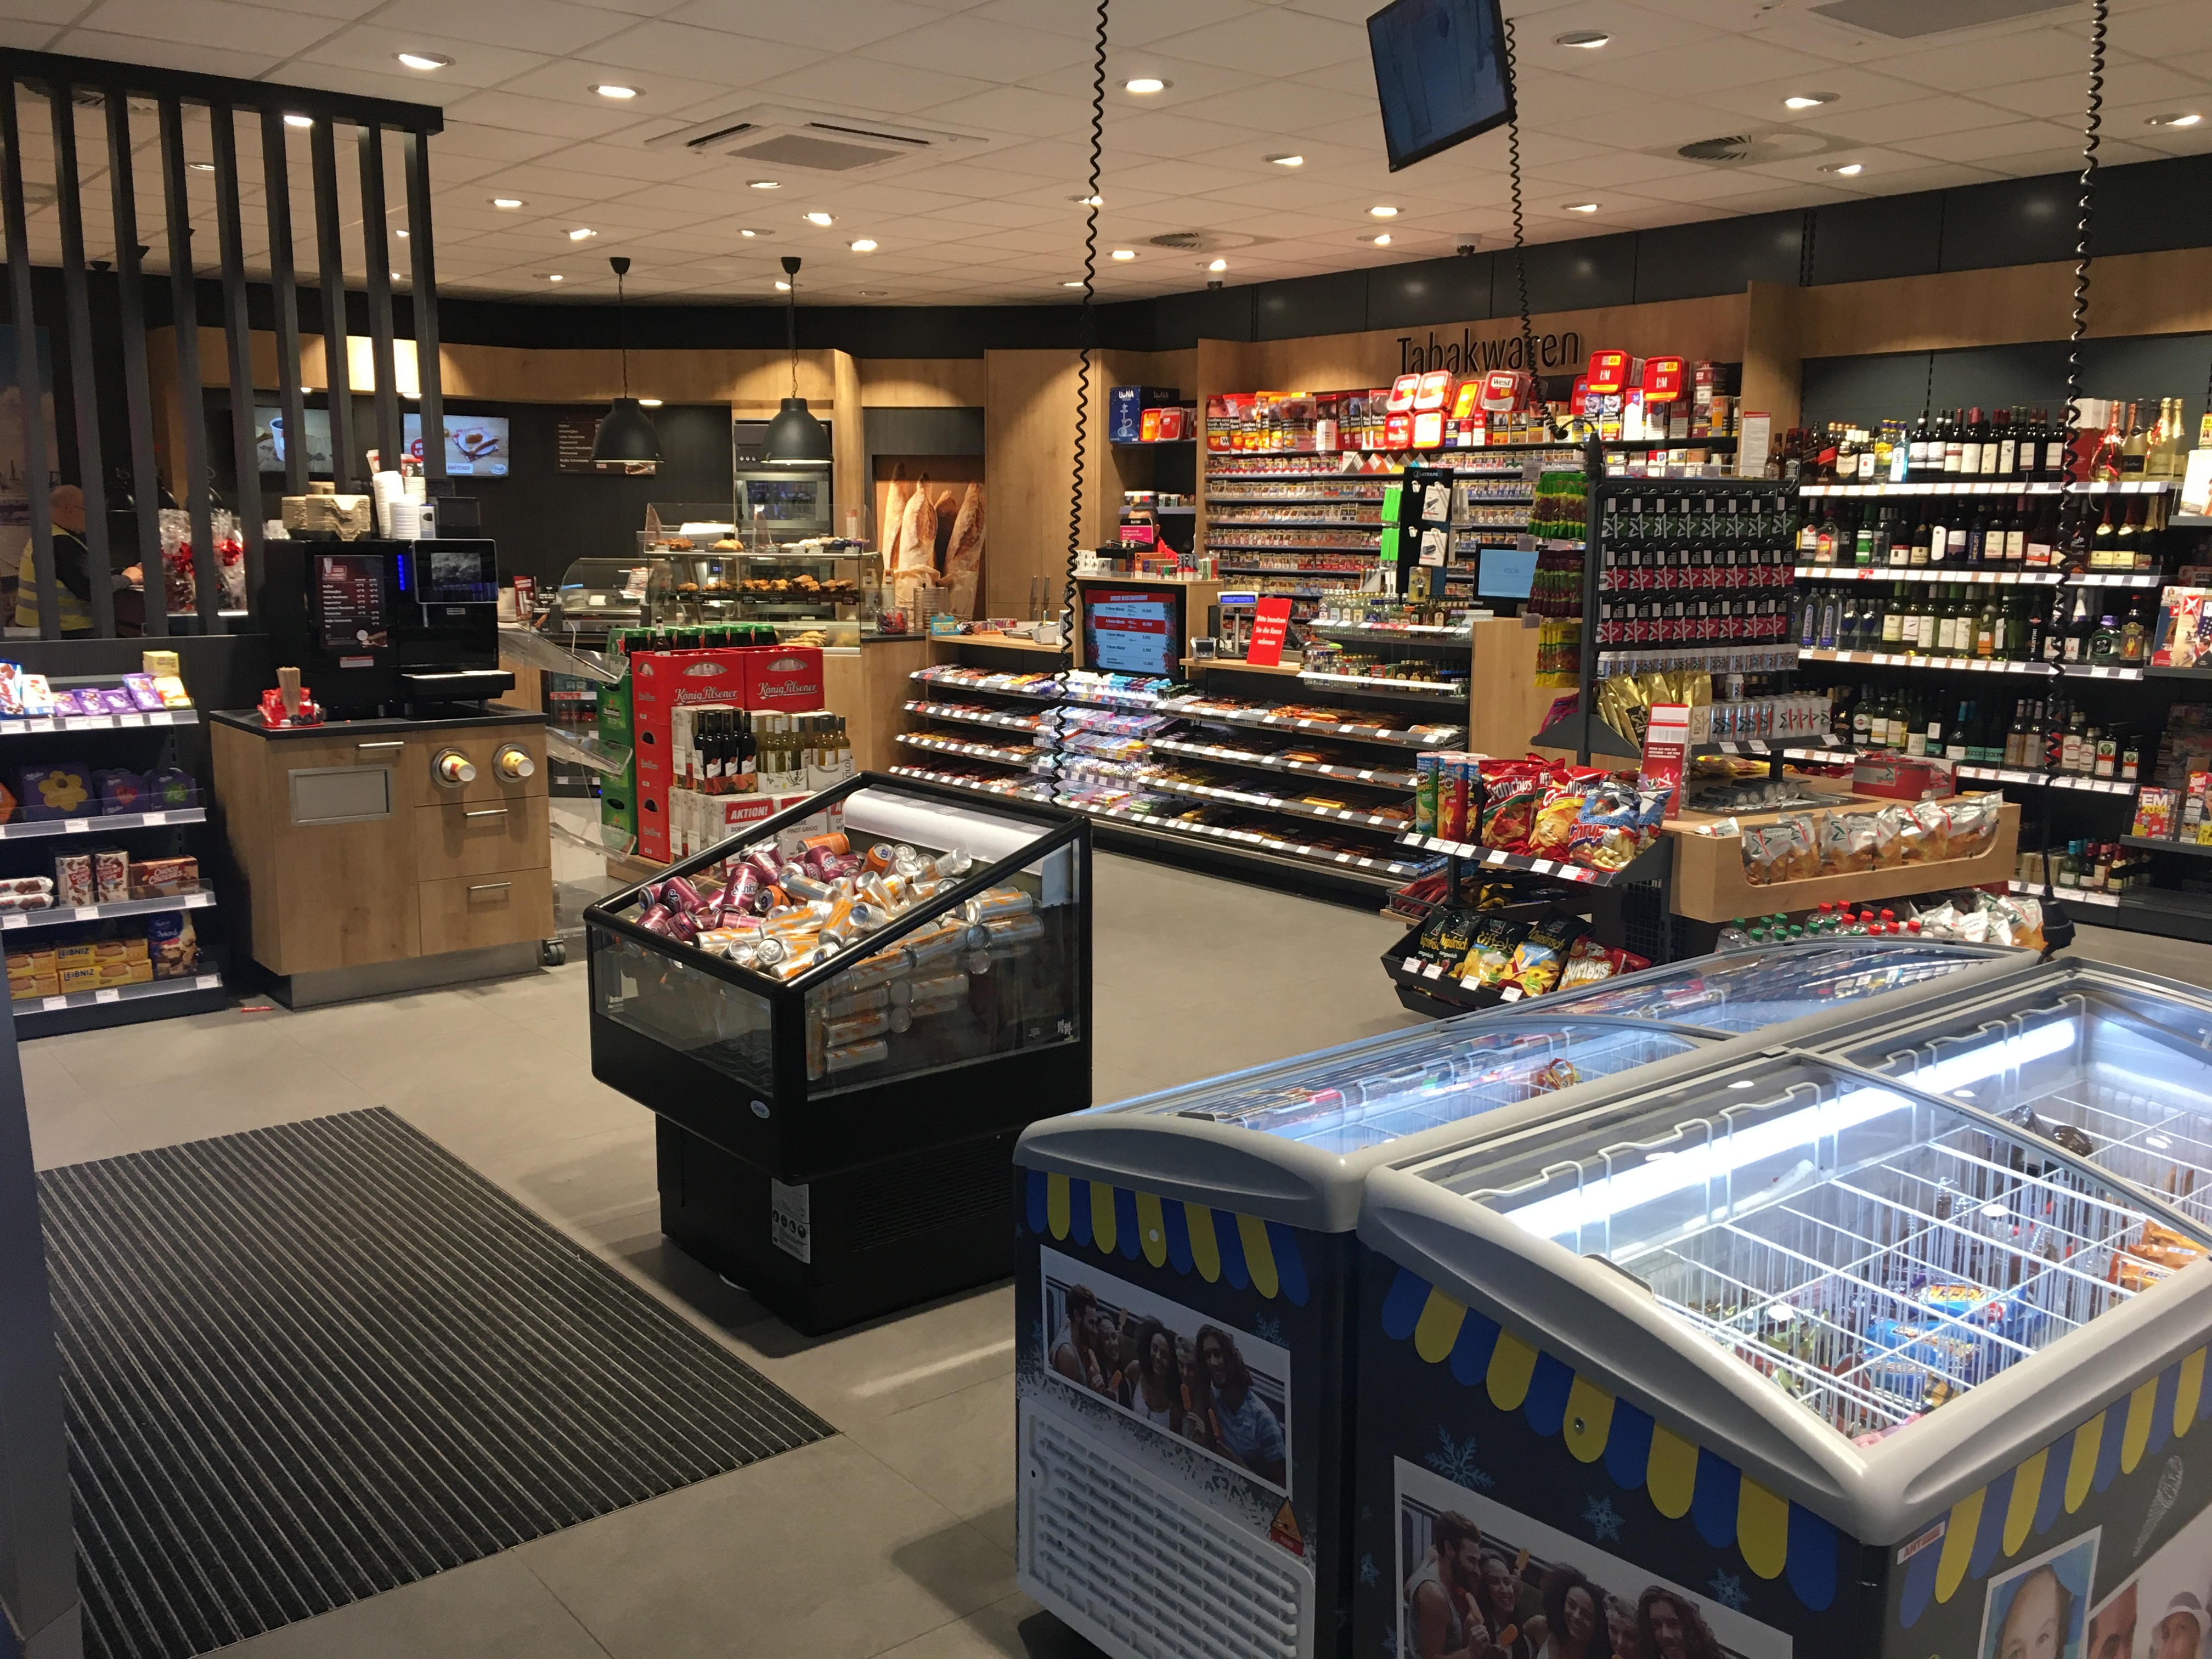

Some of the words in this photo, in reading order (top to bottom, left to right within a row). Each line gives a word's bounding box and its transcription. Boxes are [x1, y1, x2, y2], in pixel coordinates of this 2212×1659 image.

[1397, 328, 1580, 375] Tabakwaren
[1493, 377, 1511, 386] West
[1119, 390, 1134, 398] LUNA
[674, 688, 703, 702] König
[702, 686, 738, 699] Pilsener
[757, 682, 784, 696] König
[783, 680, 817, 693] Pilsener
[2142, 794, 2168, 806] EM
[731, 806, 768, 820] AKTION!
[2141, 805, 2167, 814] 2020
[1581, 811, 1625, 826] Captain
[154, 866, 179, 876] CHOCO
[59, 947, 89, 959] LEIBNIZ
[64, 969, 94, 981] LEIBNIZ
[1560, 958, 1611, 986] JUMBOS
[1928, 1285, 1994, 1304] OGGER
[1904, 1538, 1922, 1558] AHT
